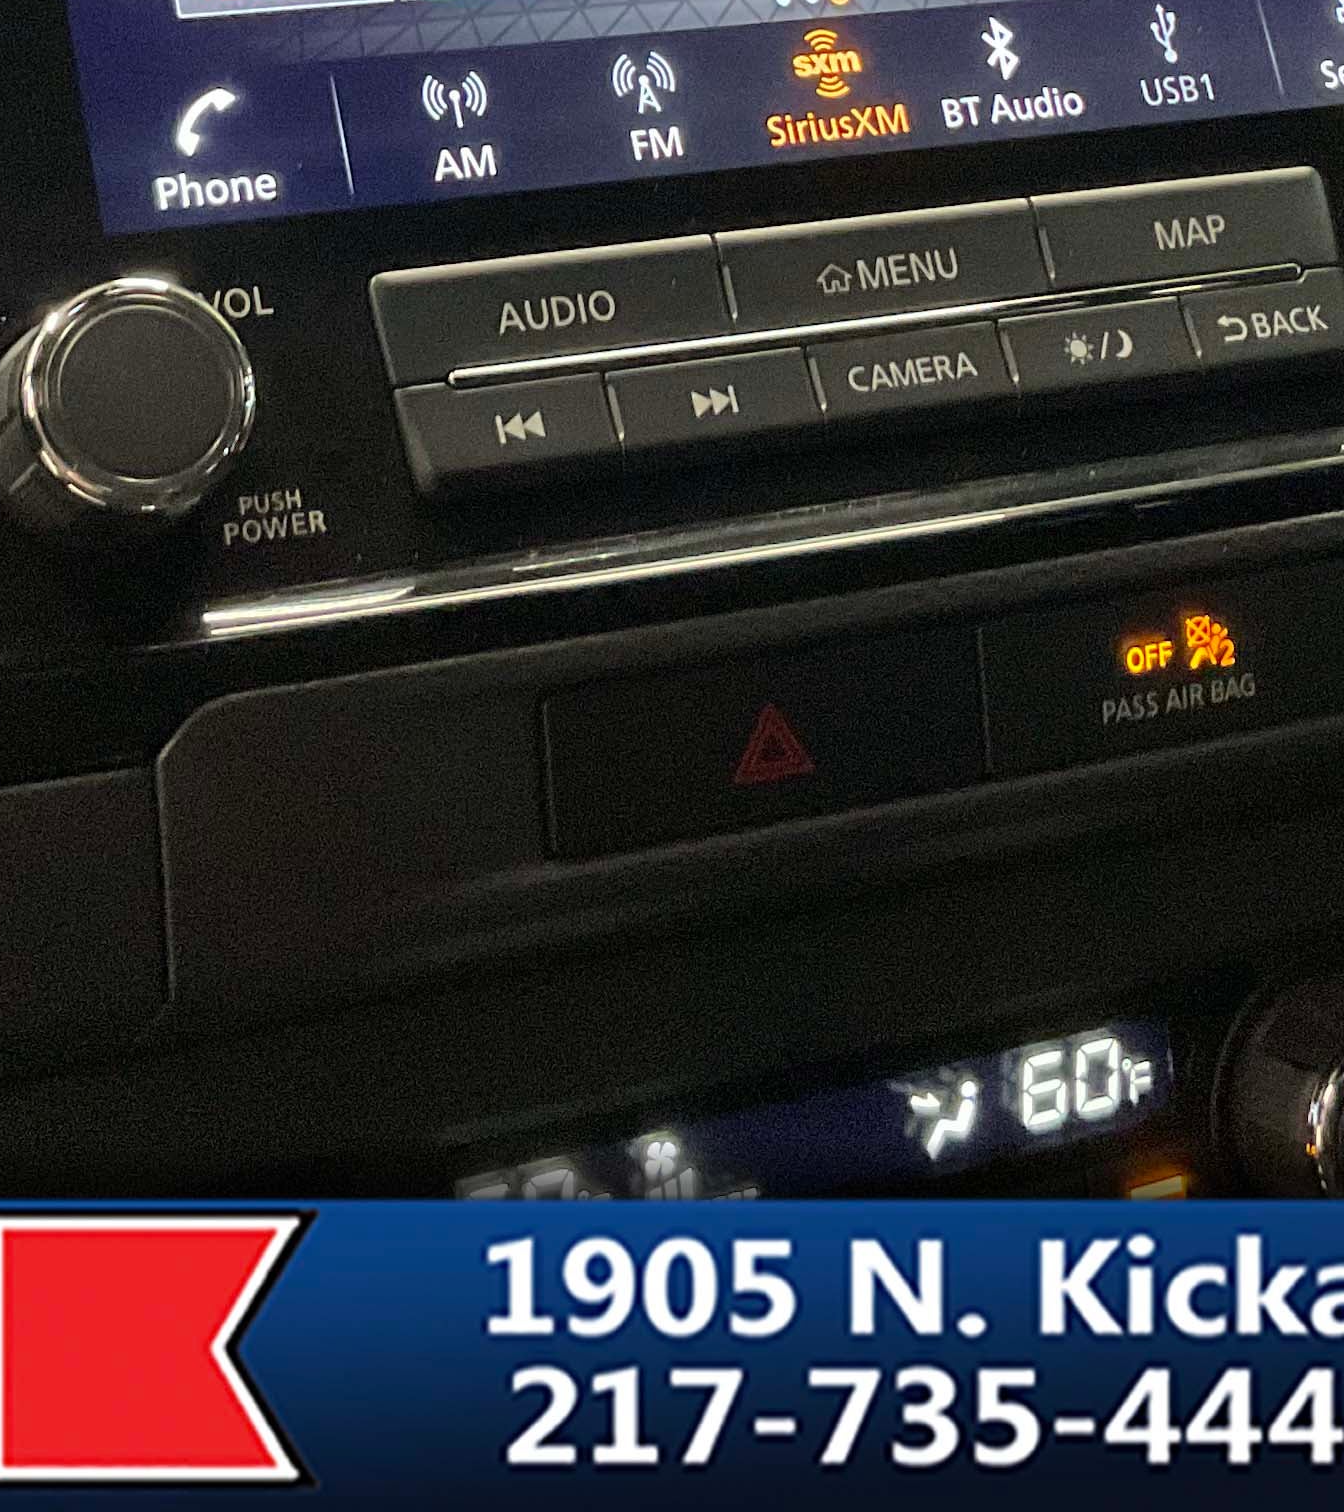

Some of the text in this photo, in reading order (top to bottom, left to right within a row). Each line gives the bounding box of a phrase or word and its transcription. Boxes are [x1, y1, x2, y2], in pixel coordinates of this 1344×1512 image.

[792, 50, 862, 78] sxm
[942, 88, 1085, 129] BT Audio
[1139, 74, 1216, 107] USB1
[766, 102, 911, 148] SiriusXM
[629, 126, 685, 162] FM
[433, 144, 498, 182] AM
[157, 173, 278, 211] Phone
[1154, 214, 1227, 251] MAP
[856, 247, 960, 292] MENU
[498, 289, 617, 335] AUDIO
[1252, 305, 1329, 342] BACK
[847, 351, 978, 396] CAMERA
[238, 489, 302, 518] PUSH
[222, 509, 328, 546] POWER
[1126, 640, 1173, 674] OFF
[1102, 672, 1256, 725] PASS AIR BAG
